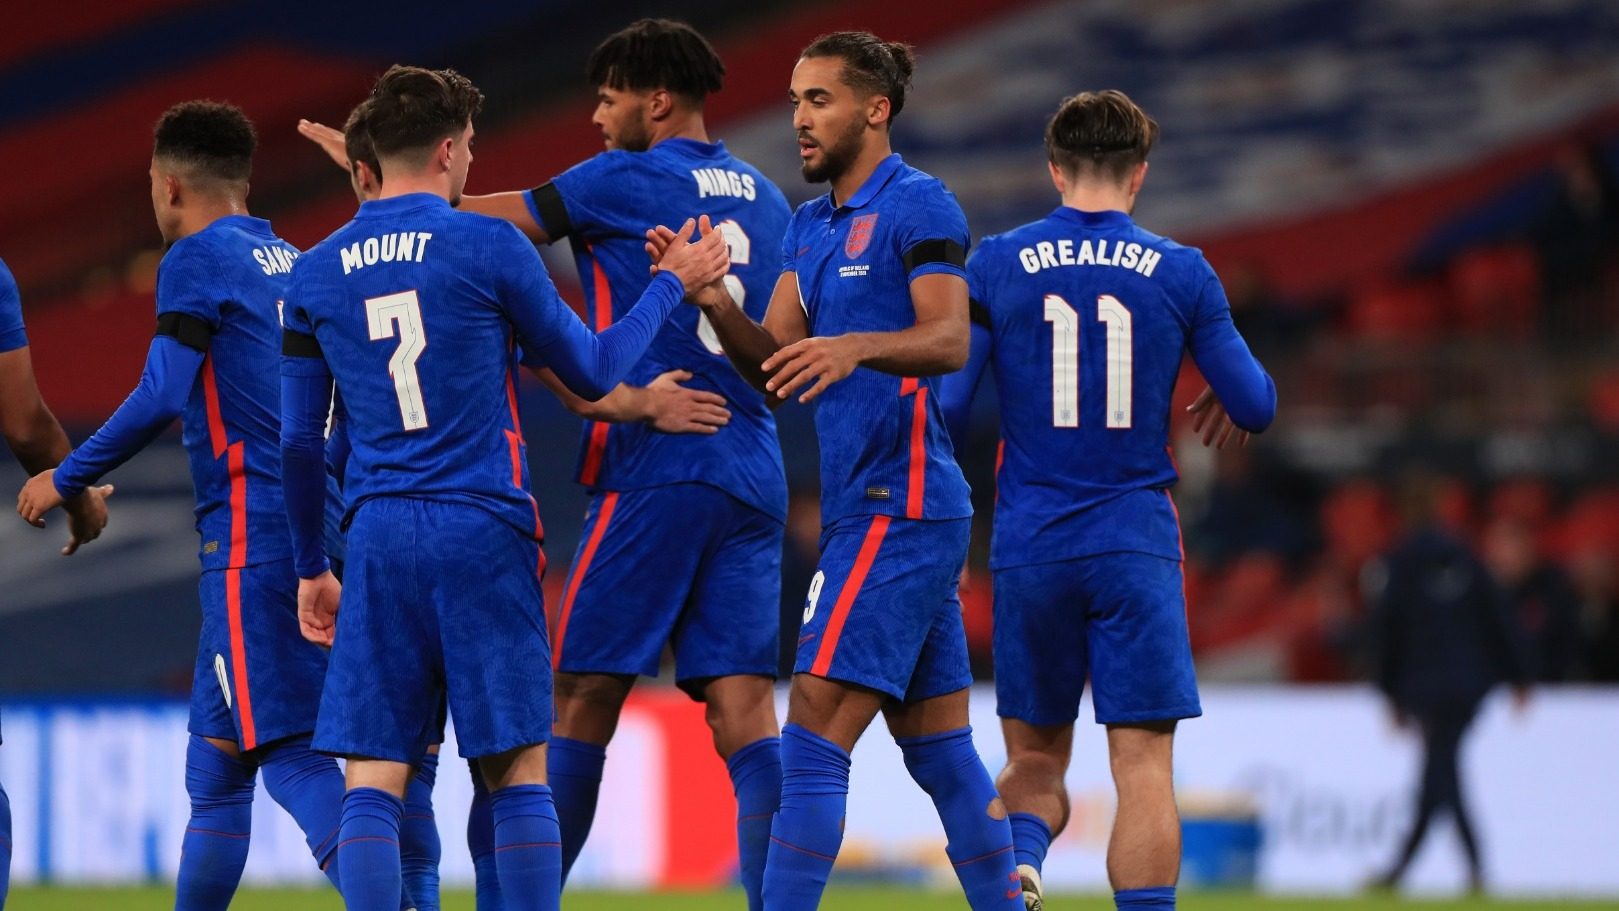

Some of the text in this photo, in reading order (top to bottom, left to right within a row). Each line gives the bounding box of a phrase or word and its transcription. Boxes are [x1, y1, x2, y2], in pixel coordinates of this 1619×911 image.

[691, 168, 757, 202] MINGS
[340, 232, 432, 275] MOUNT
[1018, 239, 1162, 277] GREALISH
[365, 289, 427, 431] 7
[1043, 293, 1132, 428] 11
[803, 570, 825, 625] 9
